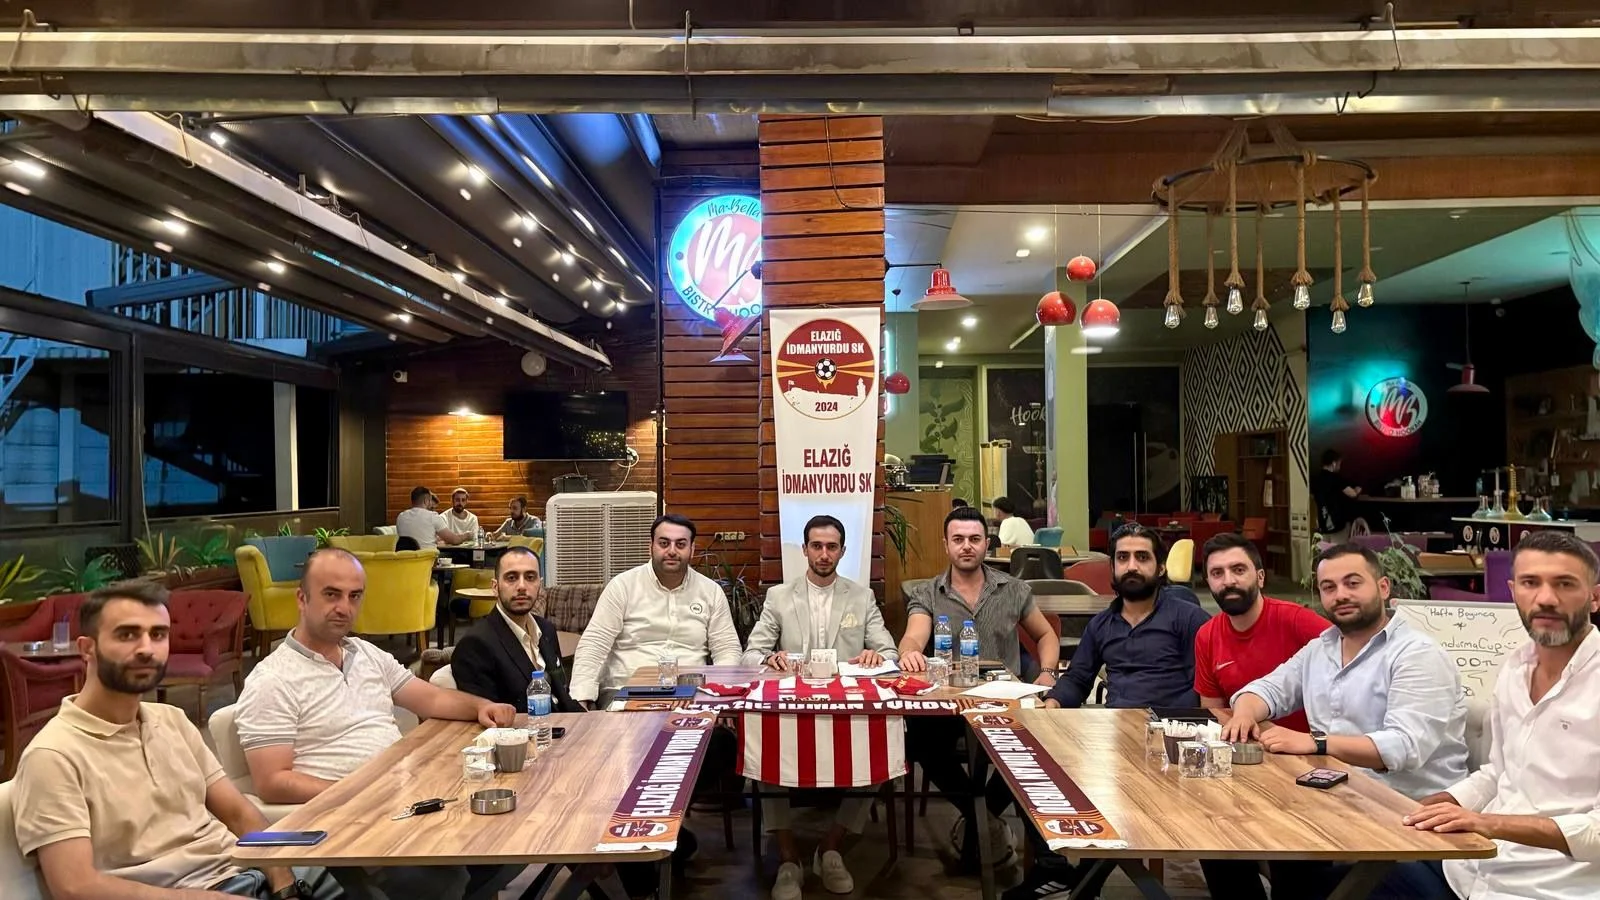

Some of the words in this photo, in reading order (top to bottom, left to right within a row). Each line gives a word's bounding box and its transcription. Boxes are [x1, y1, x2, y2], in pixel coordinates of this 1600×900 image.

[682, 285, 716, 315] BISTR
[810, 328, 842, 342] ELAZIĞ
[786, 342, 850, 355] İDMANYURDU
[851, 342, 865, 354] SK
[815, 401, 838, 412] 2024
[803, 443, 852, 468] ELAZIĞ
[782, 468, 857, 494] İDMANYURDU
[858, 472, 873, 493] SK
